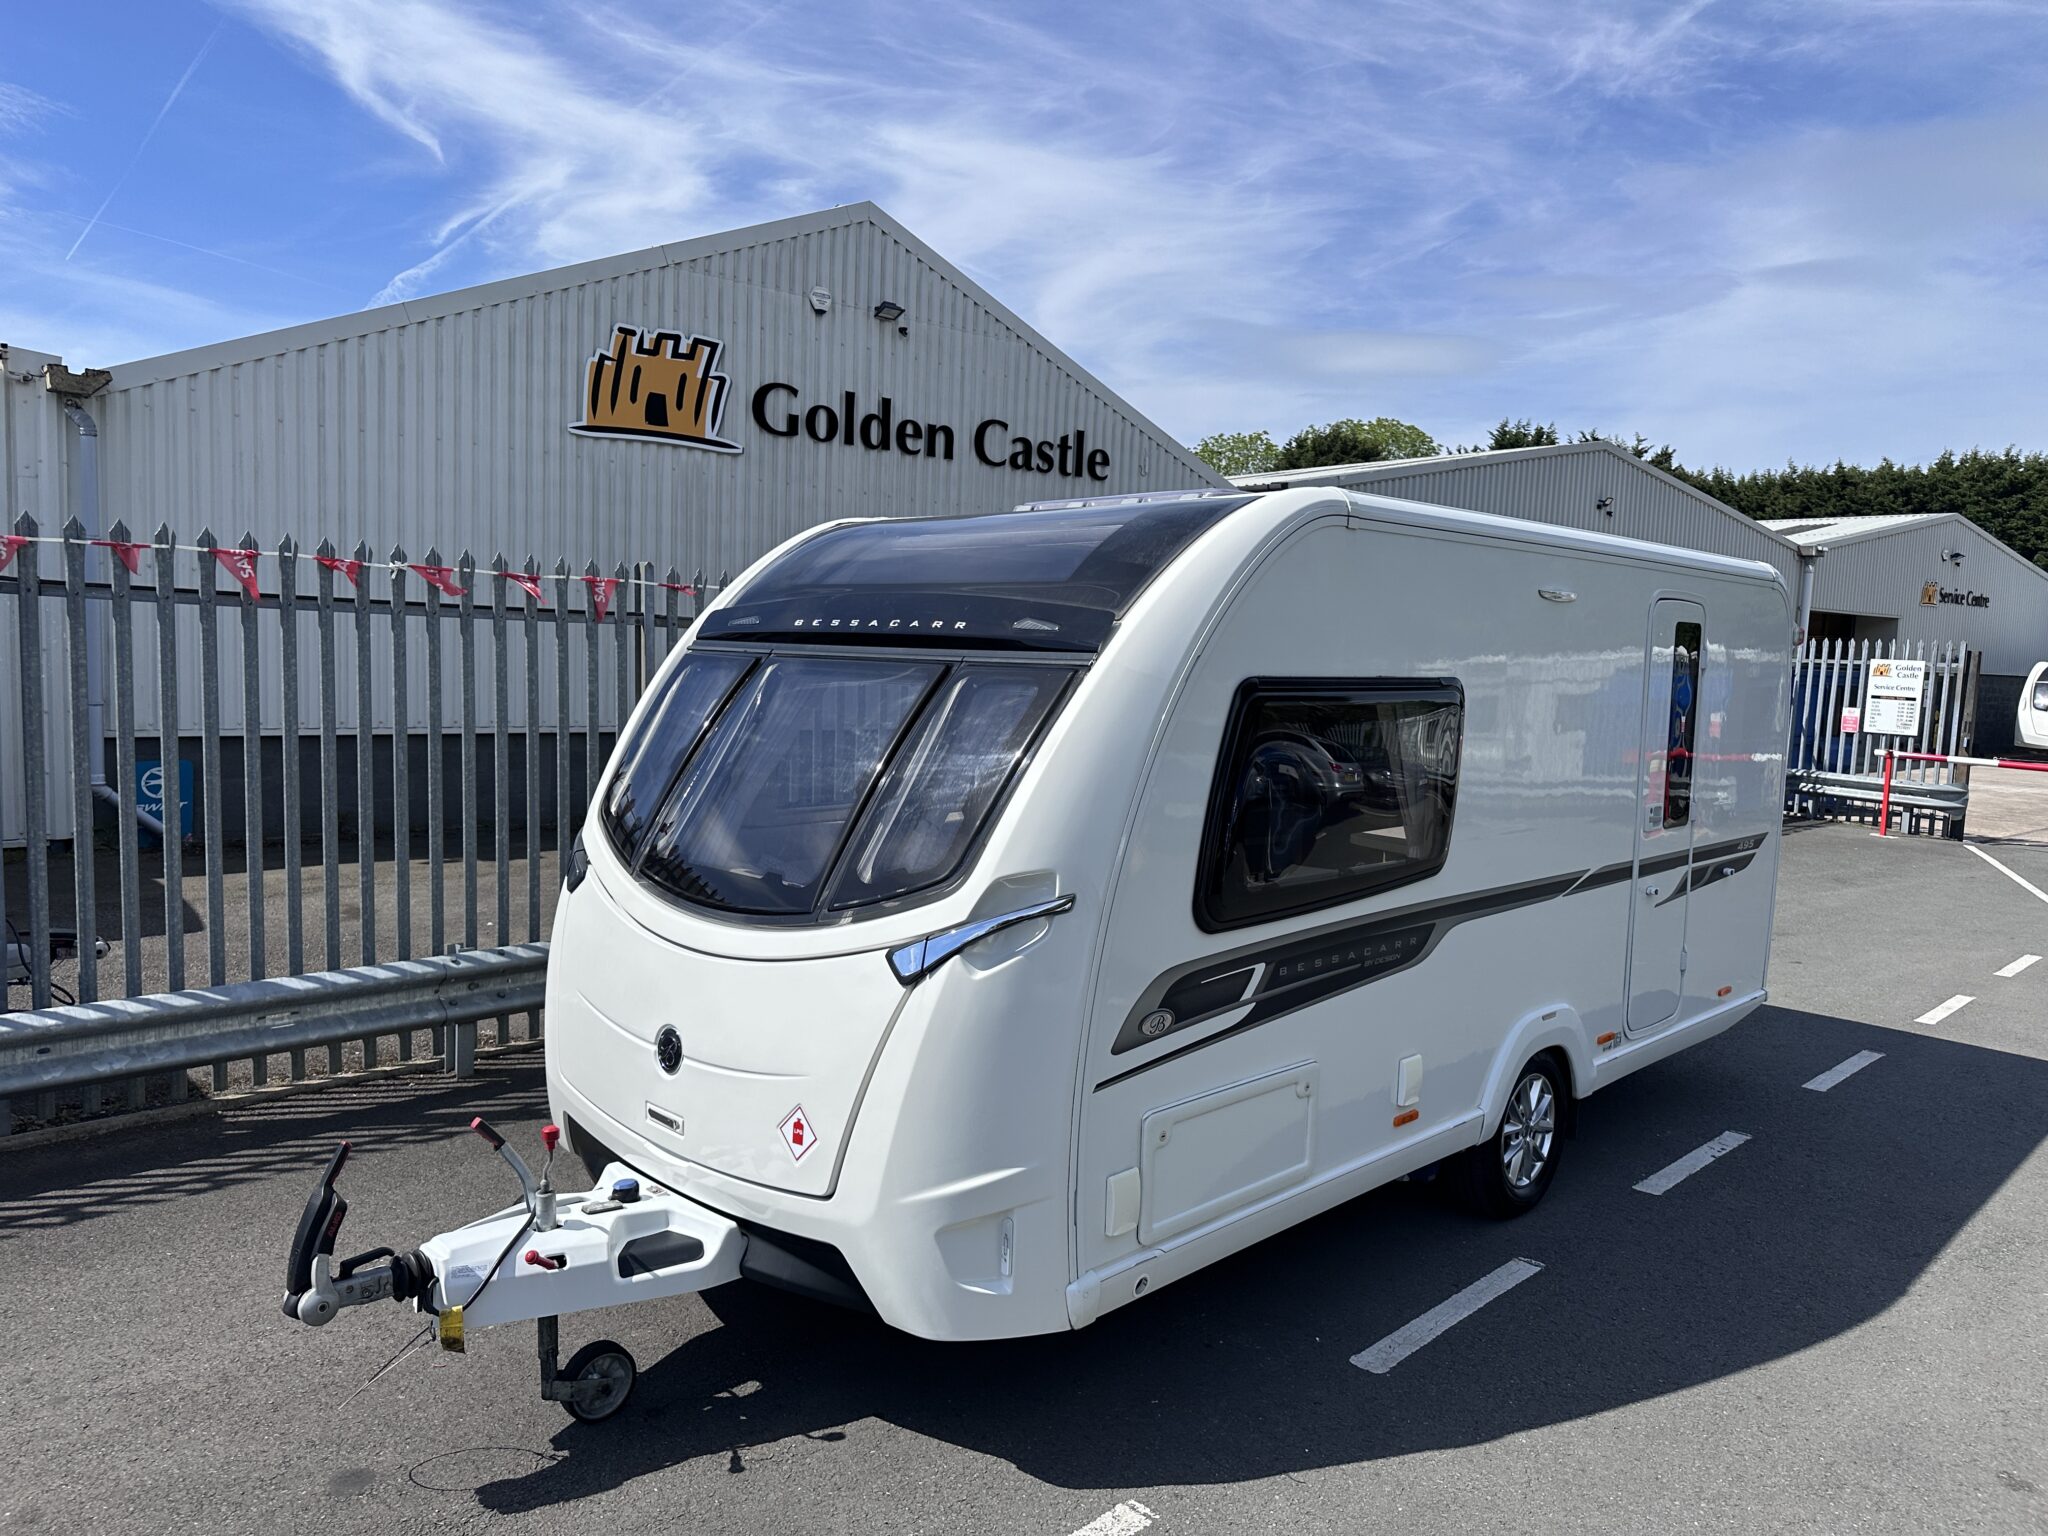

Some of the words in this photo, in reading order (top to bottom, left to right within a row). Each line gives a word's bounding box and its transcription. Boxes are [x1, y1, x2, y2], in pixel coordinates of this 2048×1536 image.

[752, 382, 955, 460] Golden
[974, 419, 1111, 482] Castle
[1939, 587, 1966, 605] Service
[1966, 591, 1990, 608] Centre
[794, 619, 968, 629] BESSACARR
[1895, 664, 1922, 672] Golden
[1279, 937, 1417, 976] BESSACARR
[1364, 960, 1374, 968] BY
[1374, 952, 1401, 966] DESIGN
